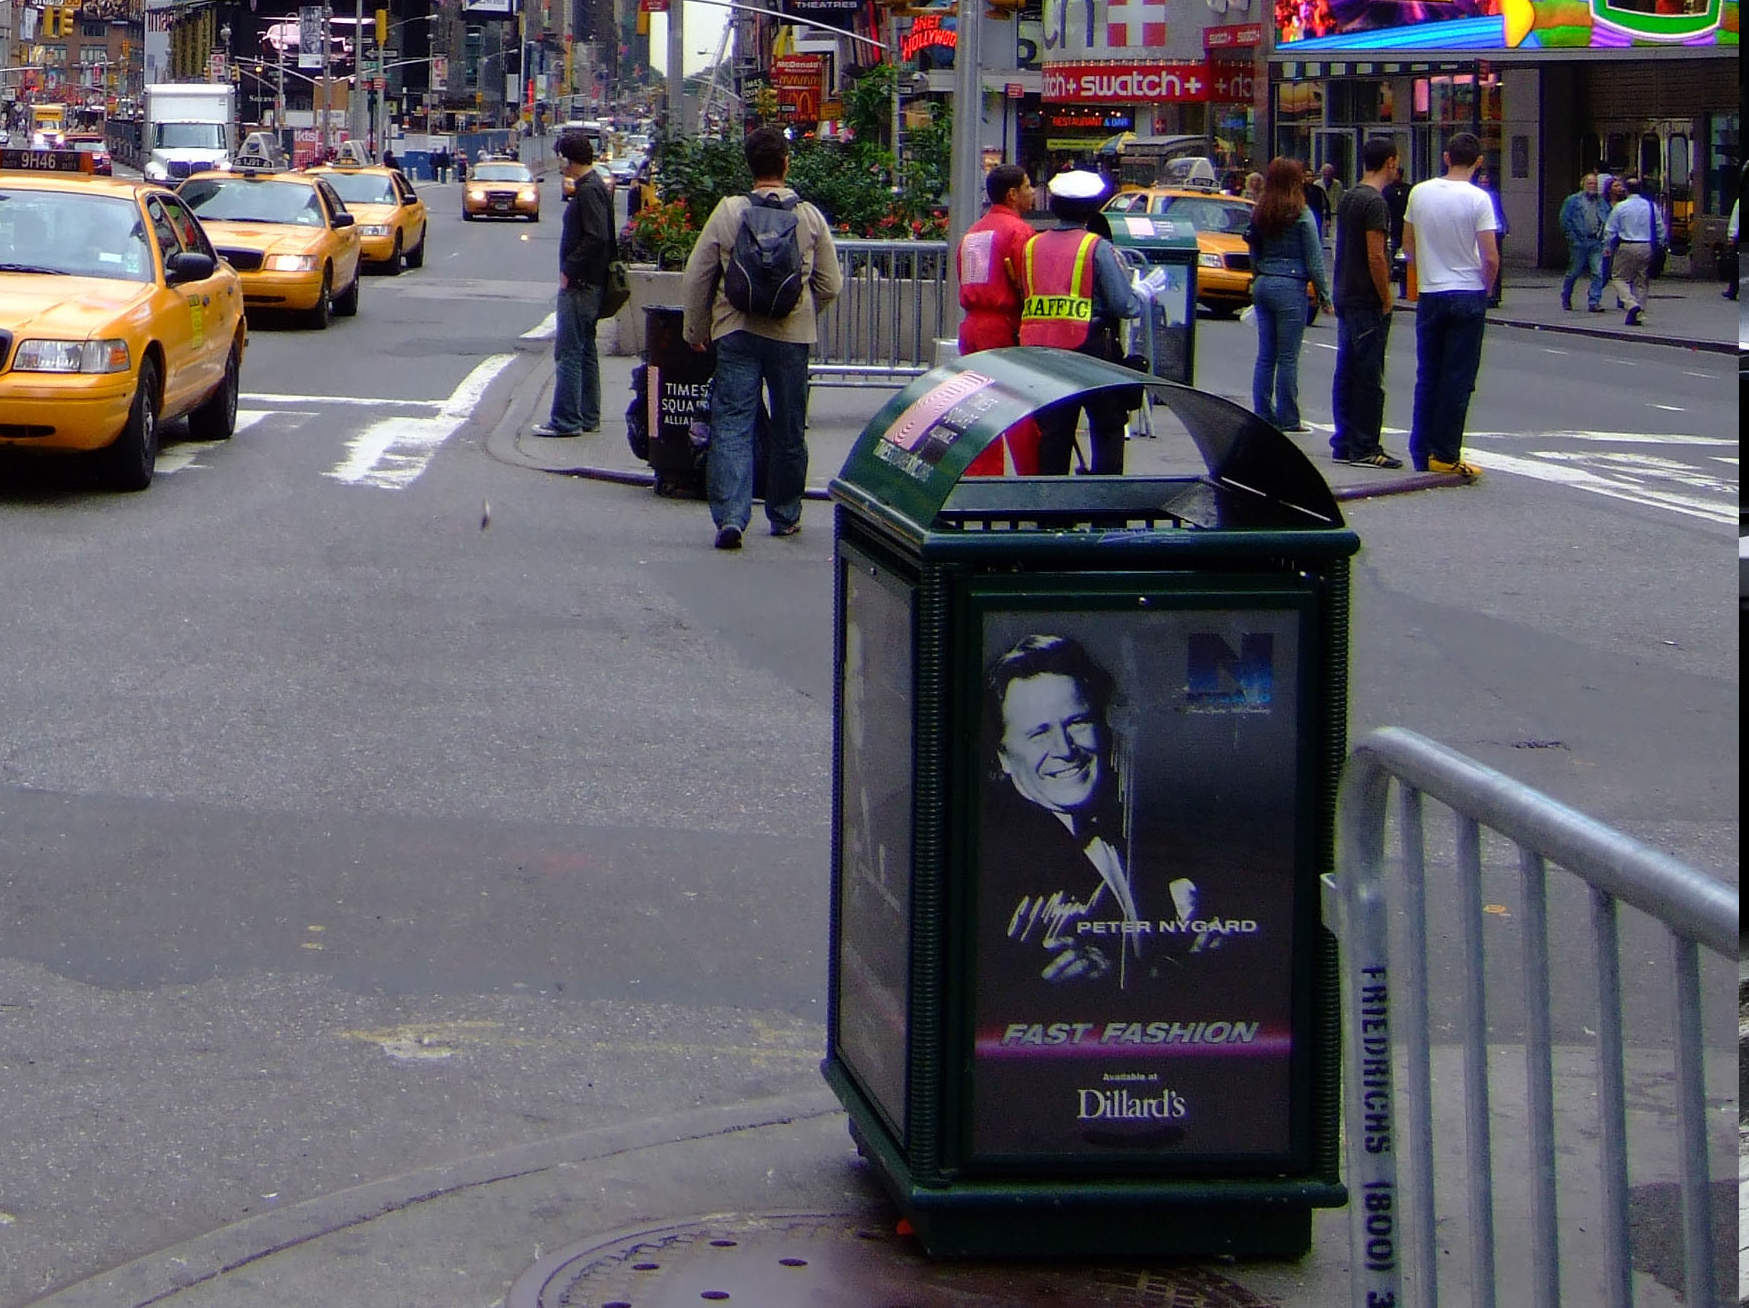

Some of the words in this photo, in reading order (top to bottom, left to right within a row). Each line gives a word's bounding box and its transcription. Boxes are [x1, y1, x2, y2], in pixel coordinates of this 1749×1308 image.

[794, 0, 857, 9] THEATRES
[1080, 70, 1181, 97] swatch
[20, 152, 57, 169] 9H46
[665, 382, 709, 397] TIMES
[661, 398, 699, 414] SQUA
[1076, 920, 1152, 934] PETER
[1001, 1022, 1093, 1046] FAST
[1100, 1021, 1259, 1045] FASHION
[1361, 965, 1392, 1155] FRIEDRICHS
[1103, 1072, 1146, 1081] Available
[1148, 1073, 1158, 1081] at
[1076, 1088, 1187, 1120] Dillard's
